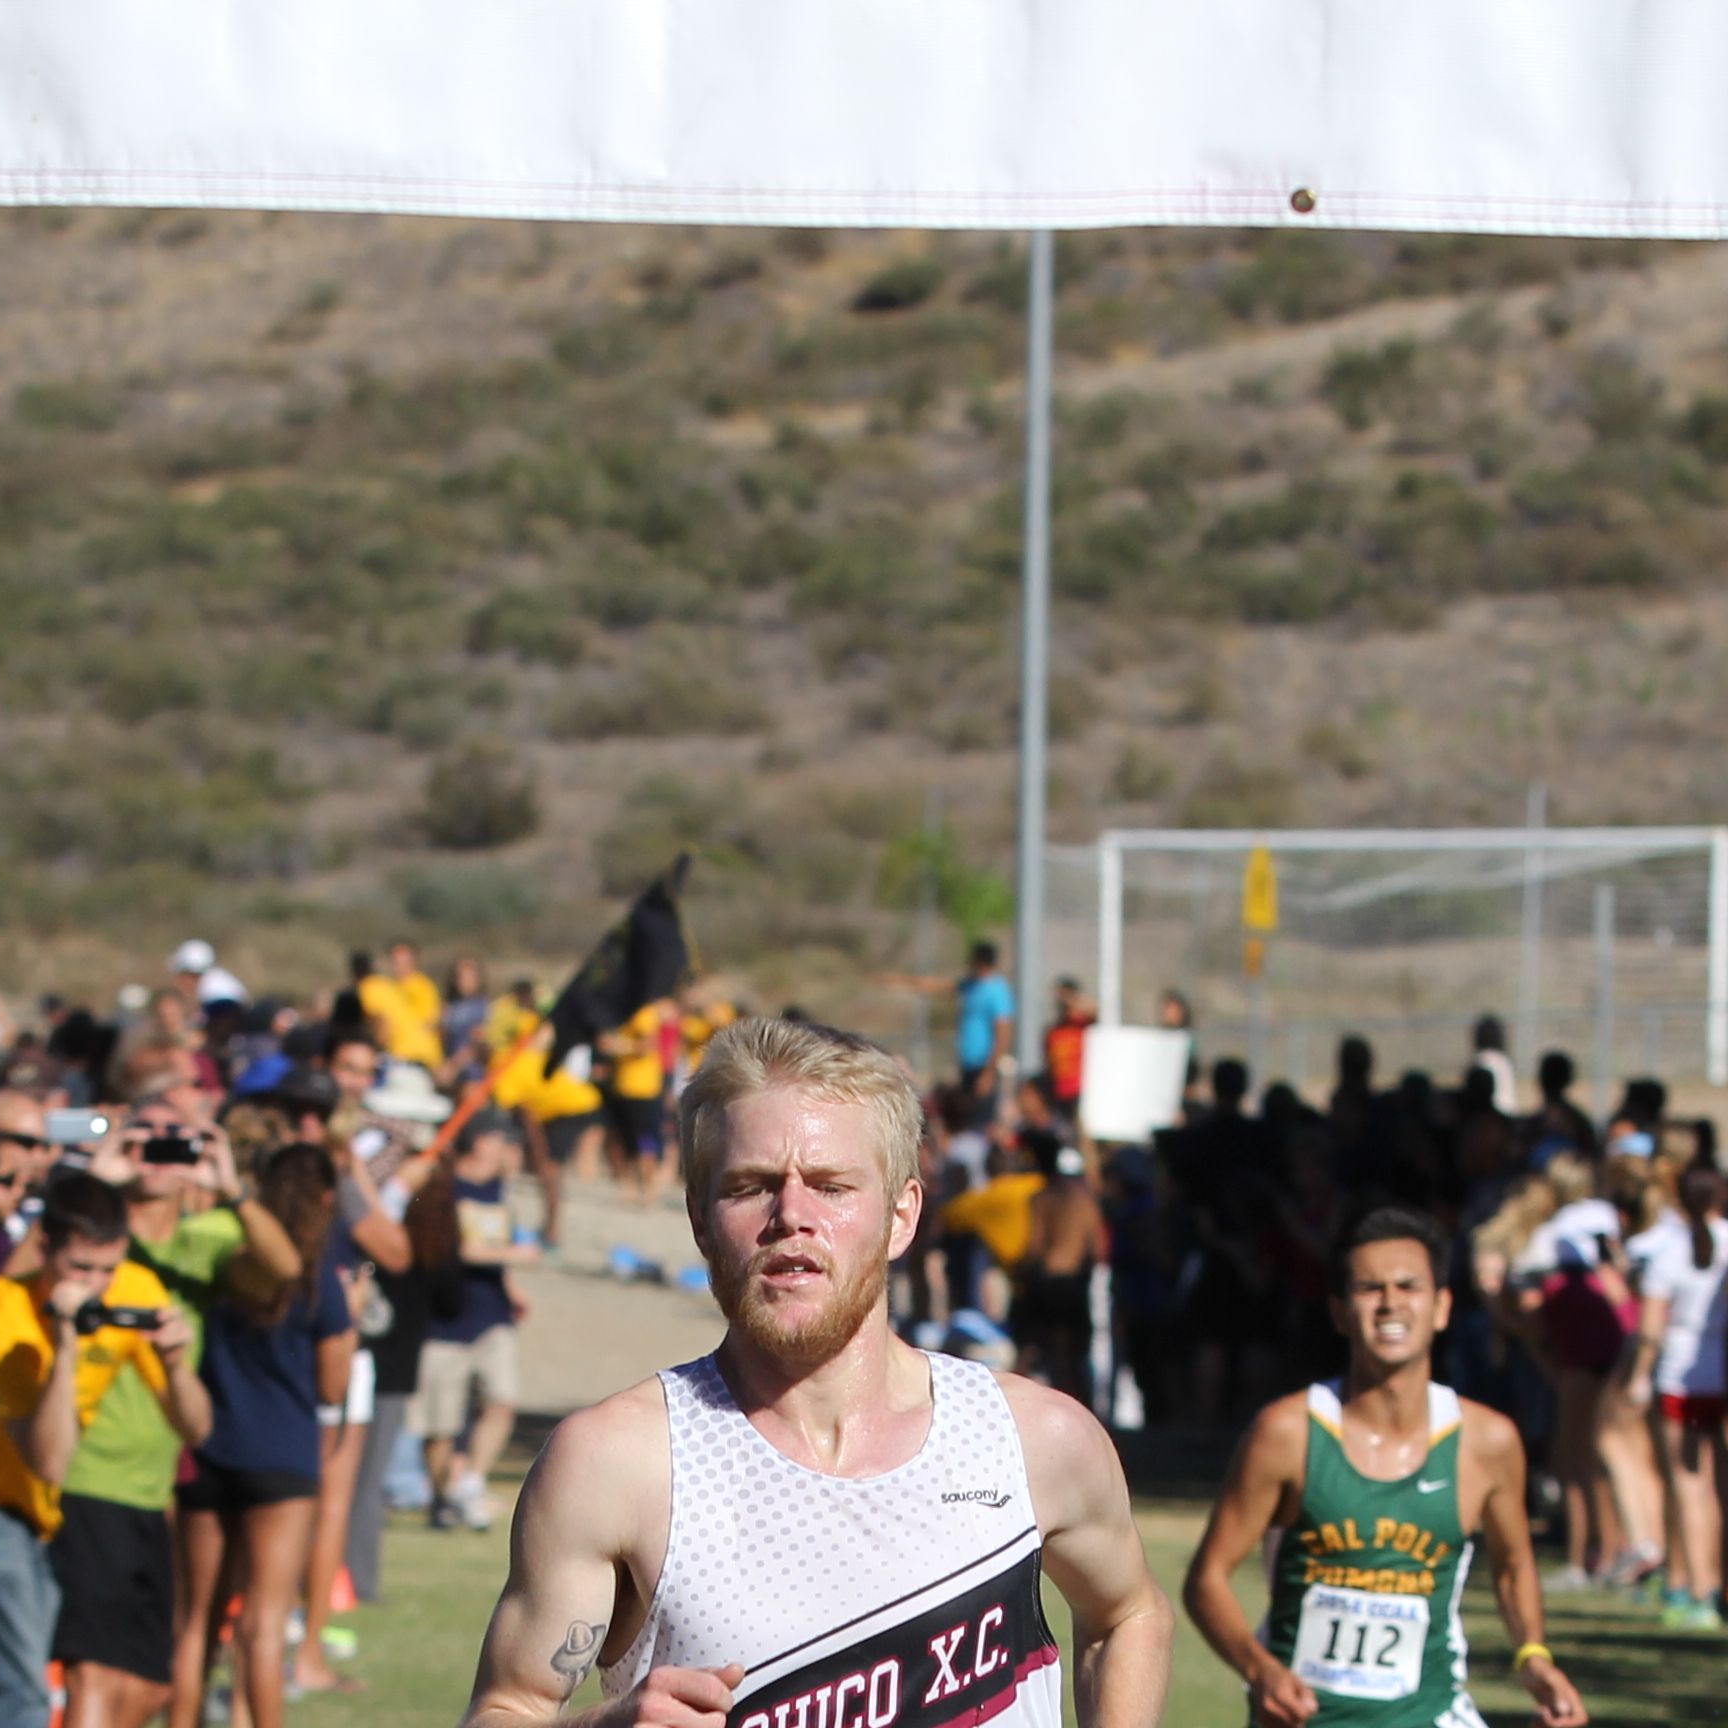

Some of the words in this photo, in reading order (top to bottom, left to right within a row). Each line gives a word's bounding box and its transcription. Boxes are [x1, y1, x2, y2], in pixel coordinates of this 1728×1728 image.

[941, 1488, 998, 1504] saucony
[924, 1604, 1009, 1705] X.C.
[1323, 1618, 1401, 1668] 112
